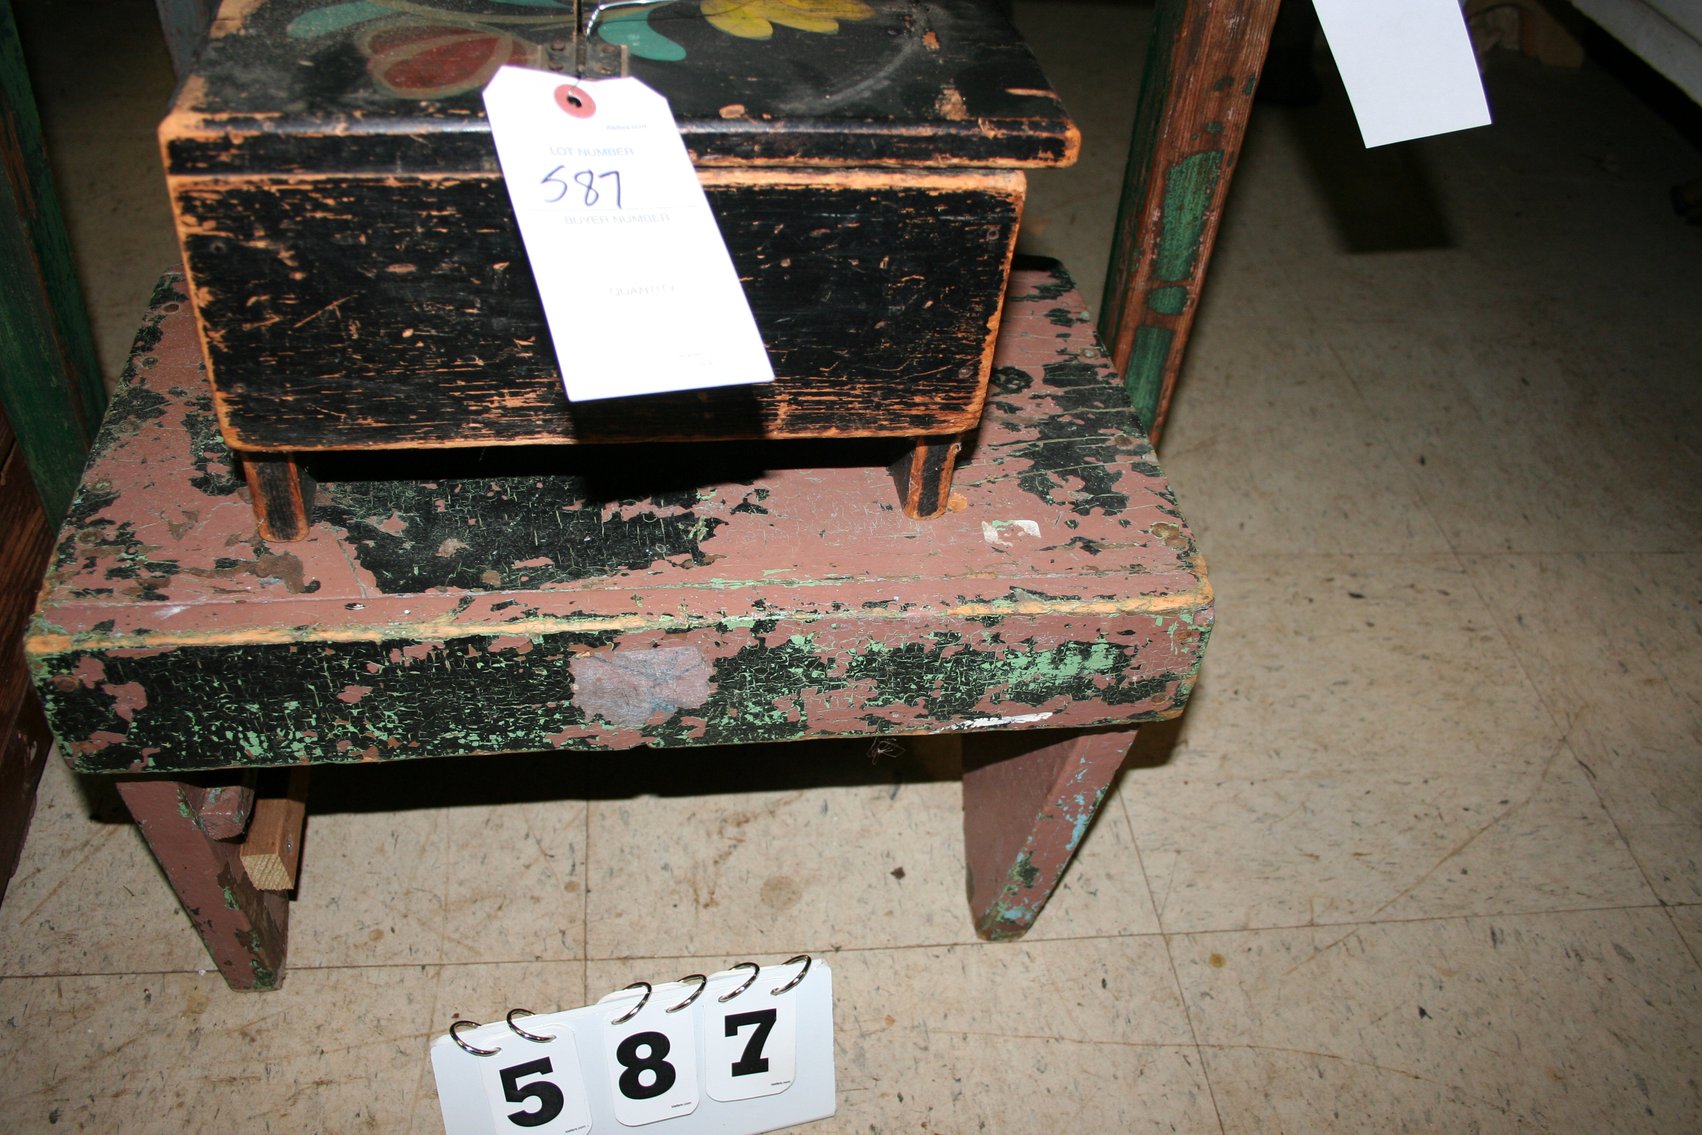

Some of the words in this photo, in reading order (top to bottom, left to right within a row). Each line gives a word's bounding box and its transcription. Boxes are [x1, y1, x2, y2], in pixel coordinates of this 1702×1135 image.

[549, 145, 574, 156] LOT
[577, 146, 635, 157] NUMBER
[540, 164, 623, 210] 587
[564, 215, 610, 225] BUYER
[613, 213, 671, 225] NUMBER
